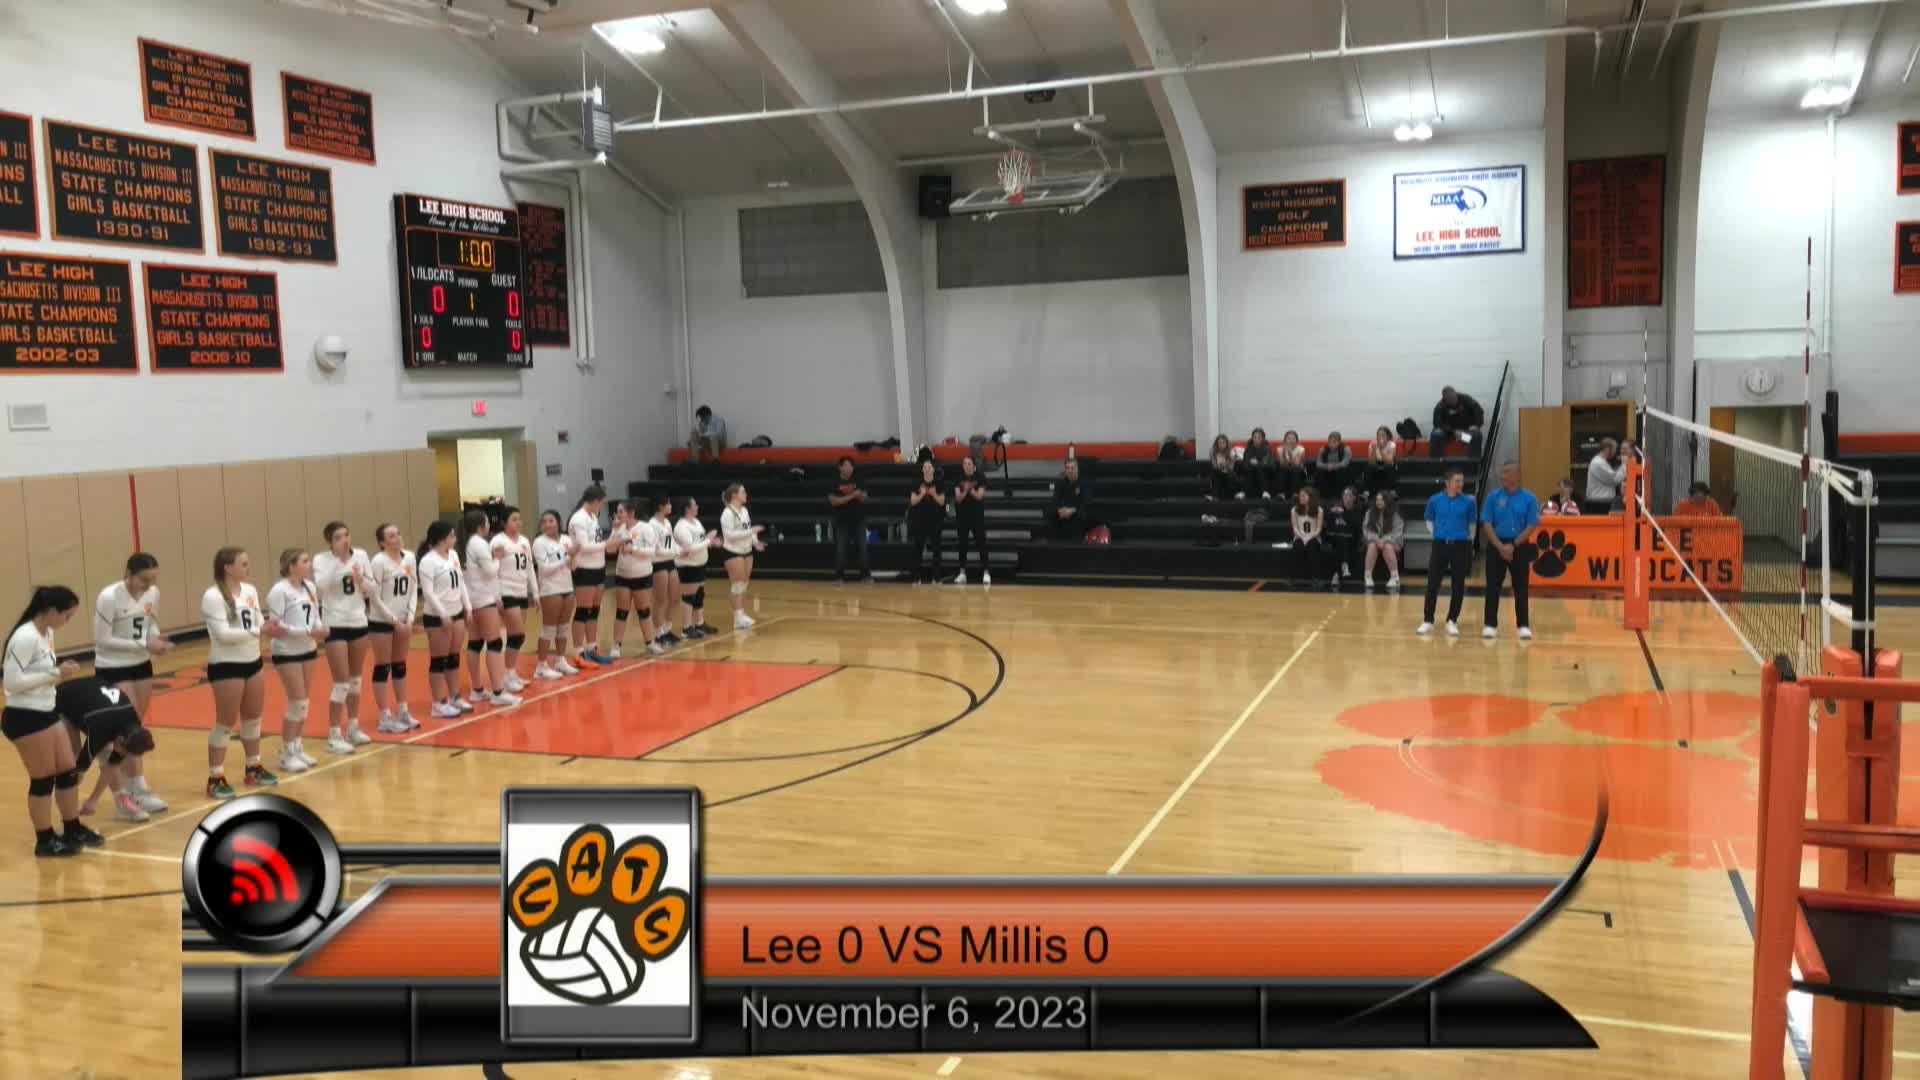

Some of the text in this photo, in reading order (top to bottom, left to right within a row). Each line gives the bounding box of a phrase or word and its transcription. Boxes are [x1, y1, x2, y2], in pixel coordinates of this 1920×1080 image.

[168, 50, 193, 63] LEE
[152, 80, 247, 108] GIRLS BASKETBALL
[166, 95, 236, 117] CHAMPIONS
[77, 133, 171, 161] LEE HIGH
[55, 148, 192, 185] MASSACHUSETTS DIVISION III
[236, 160, 311, 184] LEE HIGH
[61, 171, 192, 205] STATE CHAMPIONS
[220, 175, 282, 198] MASSACHUSETTS
[286, 184, 316, 202] DIVISION
[67, 194, 191, 224] GIRLS BASKETBALL
[224, 194, 328, 222] STATE CHAMPIONS
[419, 198, 507, 224] LEE HIGH SCHOOL
[1278, 209, 1311, 221] GOLF
[96, 220, 169, 240] 1990-91
[227, 215, 327, 240] GIRLS BASKETBALL
[1261, 221, 1328, 233] CHAMPIONS
[1416, 226, 1502, 242] LEE HIGH SCHOOL
[460, 239, 493, 268] 1:00
[7, 260, 95, 281] LEE HIGH
[181, 271, 248, 289] LEE HIGH
[491, 272, 517, 288] GUEST
[63, 283, 101, 303] DIVISION
[151, 288, 223, 308] MASSACHUSETTS
[227, 294, 258, 310] DIVISION
[432, 284, 446, 313] 0
[40, 303, 118, 323] CHAMPIONS
[508, 291, 520, 318] 0
[160, 310, 271, 329] STATE CHAMPIONS
[36, 326, 118, 345] BASKETBALL
[156, 329, 277, 348] GIRLS BASKETBALL
[421, 325, 432, 349] 0
[511, 329, 522, 351] 0
[15, 346, 101, 363] 2002-03
[514, 552, 528, 571] 13
[1587, 556, 1734, 583] WICATS
[341, 575, 355, 595] 8
[393, 575, 409, 596] 10
[449, 571, 460, 590] 11
[240, 610, 252, 630] 6
[301, 603, 312, 626] 7
[131, 617, 145, 640] 5
